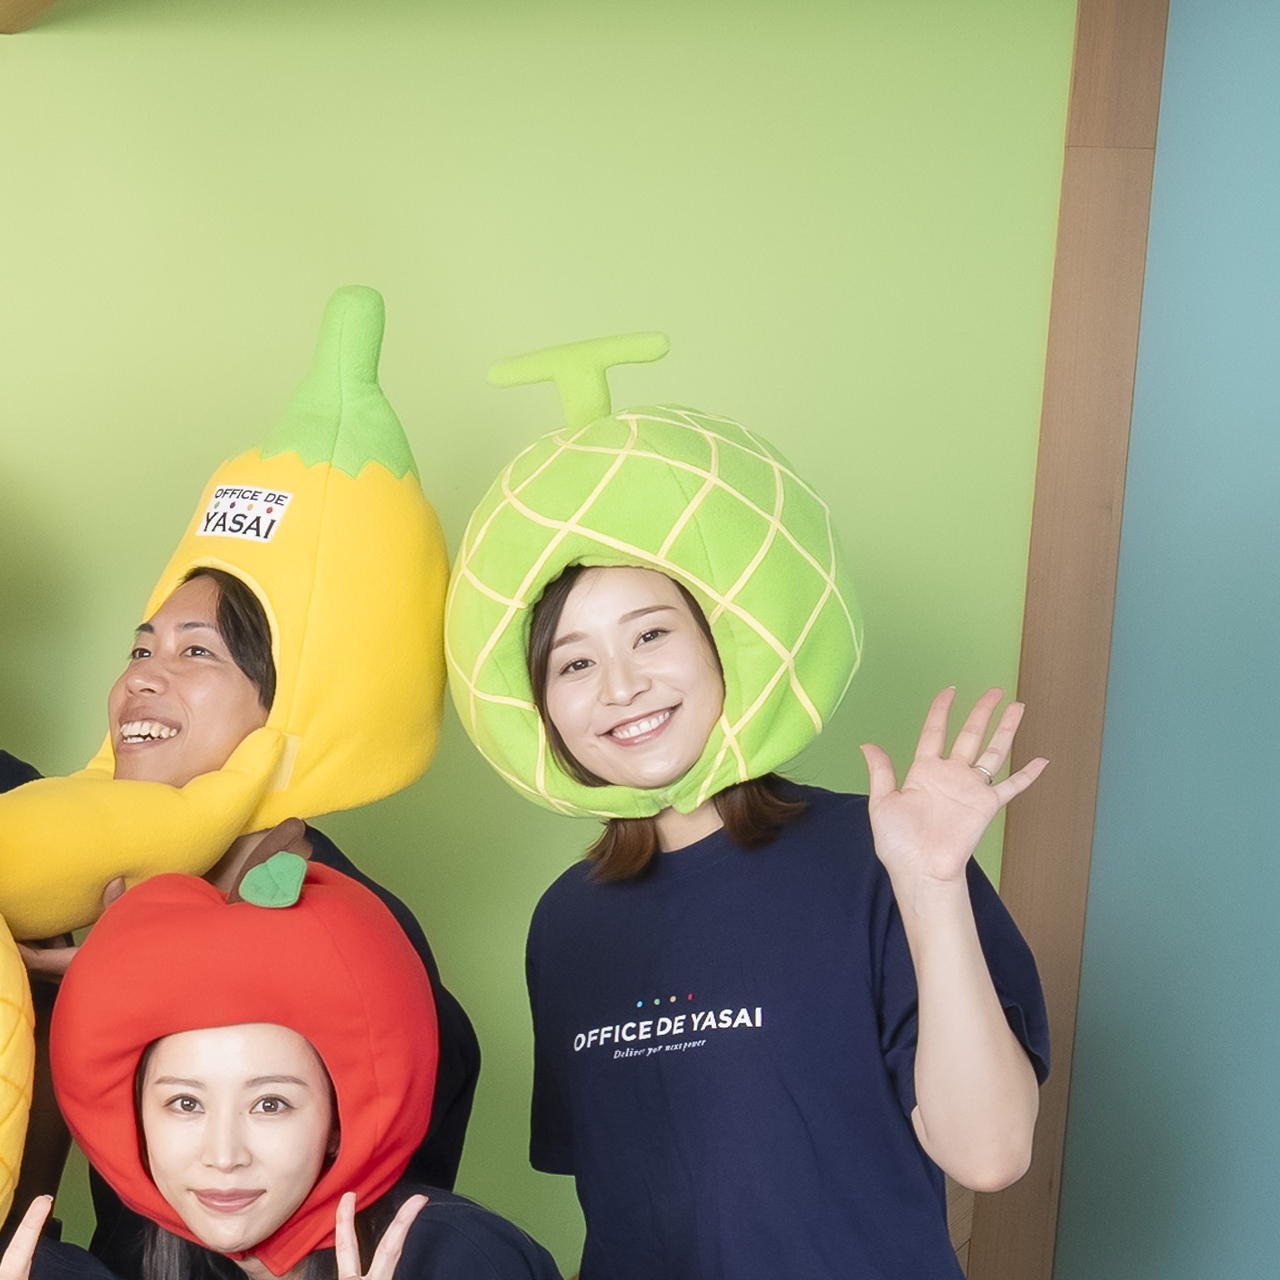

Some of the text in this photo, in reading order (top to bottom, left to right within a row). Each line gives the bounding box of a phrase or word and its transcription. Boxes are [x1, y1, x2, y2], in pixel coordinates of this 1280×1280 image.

[214, 488, 288, 506] OFFICE DE
[203, 511, 276, 539] YASAI
[573, 1007, 762, 1051] OFFICE DE YASAI
